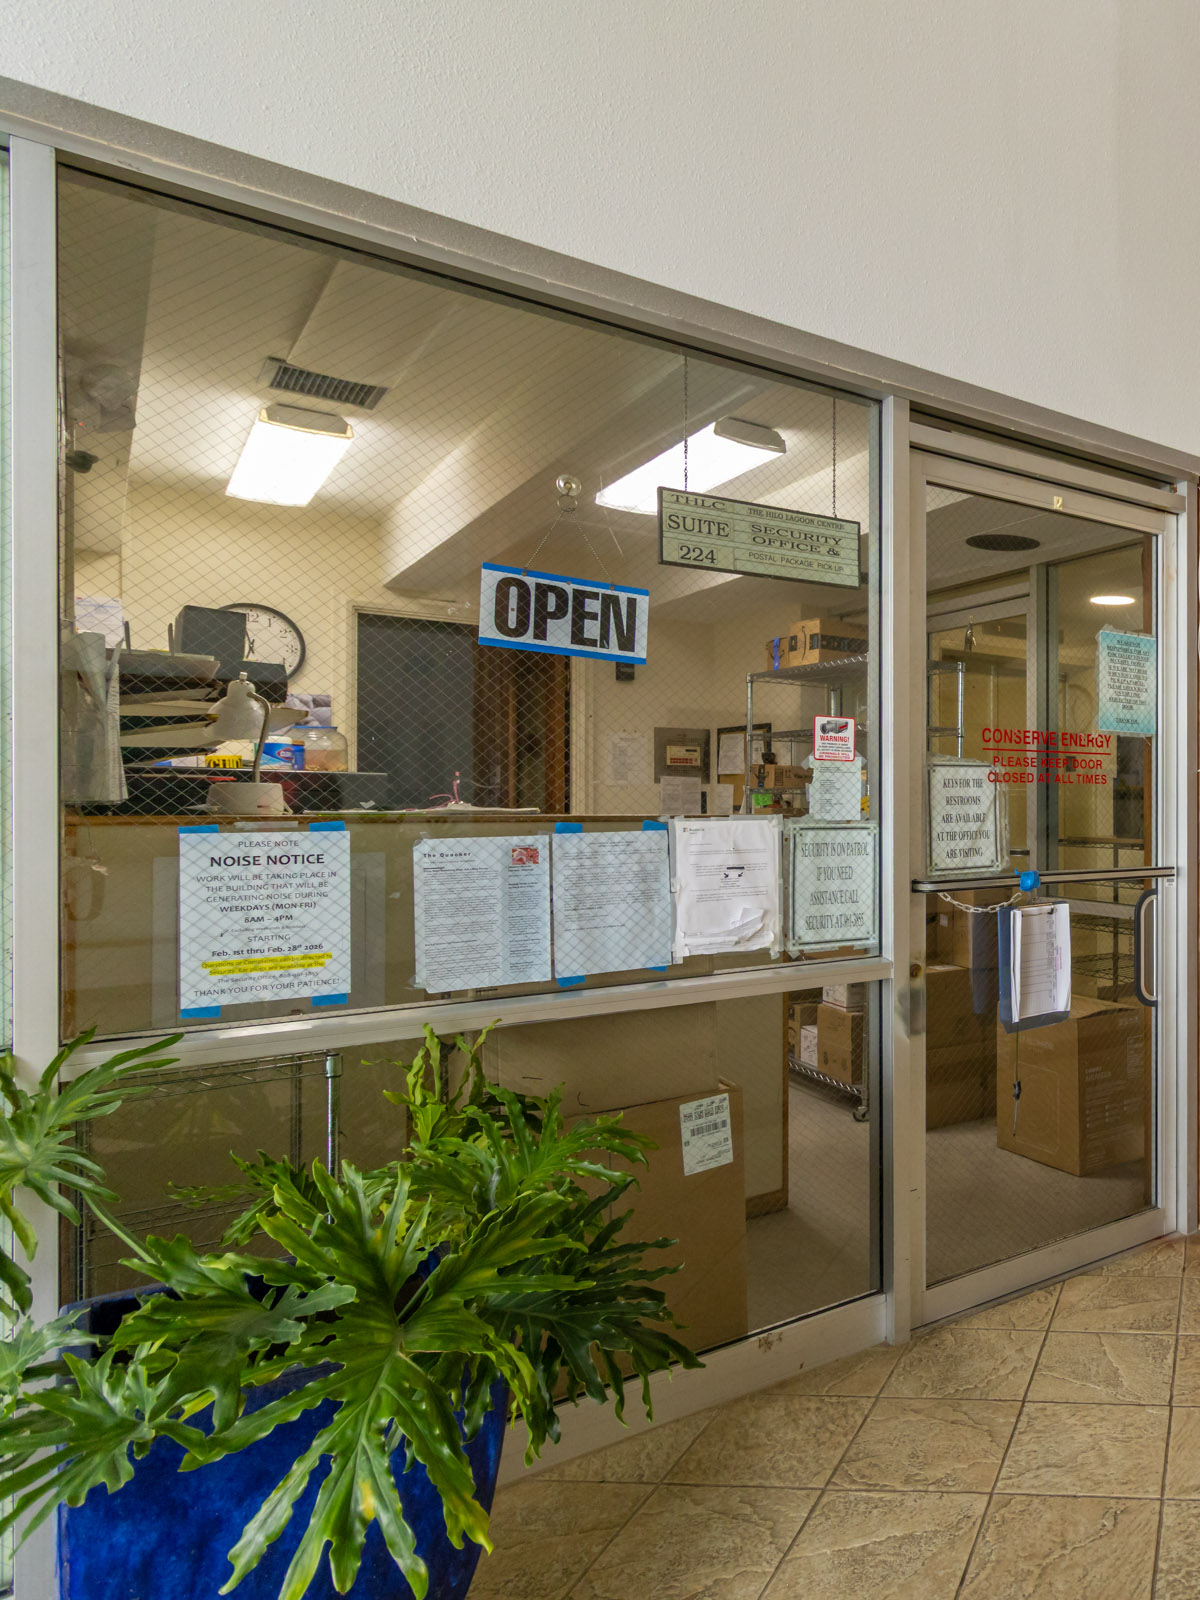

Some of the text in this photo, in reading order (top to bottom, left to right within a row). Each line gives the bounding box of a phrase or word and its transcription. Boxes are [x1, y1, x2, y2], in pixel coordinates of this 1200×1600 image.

[671, 494, 726, 511] THLC
[667, 514, 730, 538] SUITE
[748, 508, 845, 530] THE HILO LAGOON CENTRE
[751, 524, 842, 546] SECURITY
[752, 535, 840, 557] OFFICE &
[679, 545, 717, 564] 224
[748, 551, 844, 572] POSTAL PACKAGE PICK UP
[494, 576, 638, 653] OPEN
[819, 735, 850, 743] WARNING!
[981, 727, 1112, 749] CONSERVE ENERGY
[992, 755, 1103, 770] PLEASE KEEP DOOR
[942, 778, 984, 789] KEYS FOR THE
[987, 771, 1108, 785] CLOSED AT ALL TIMES
[945, 795, 981, 806] RESTROOMS
[942, 812, 987, 824] ARE AVAILABLE
[936, 829, 991, 842] AT THE OFFICE YOU
[237, 840, 273, 848] PLEASE
[801, 841, 870, 858] SECURITY IS ON PATROL
[210, 853, 326, 868] NOISE NOTICE
[945, 847, 983, 859] ARE VISITING
[196, 875, 227, 883] WORK
[227, 874, 249, 882] WILL
[265, 872, 298, 880] TAKING
[299, 871, 326, 879] PLACE
[327, 870, 337, 878] IN
[823, 866, 836, 881] YOU
[836, 865, 854, 880] NEED
[206, 885, 223, 893] THE
[226, 883, 269, 893] BUILDING
[270, 882, 294, 891] THAT
[295, 881, 316, 890] WILL
[206, 891, 329, 903] GENERATING NOISE DURING
[809, 889, 860, 906] ASSISTANCE CALL
[219, 902, 317, 913] WEEKDAYS (MON-FRI)
[244, 916, 265, 924] 8AM
[273, 914, 294, 923] 4PM
[805, 914, 834, 931] SECURITY
[247, 933, 291, 943] STARTING
[247, 947, 265, 955] thru
[304, 943, 324, 951] 2026
[194, 978, 340, 997] THANK YOU FOR YOUR PATIENCE!
